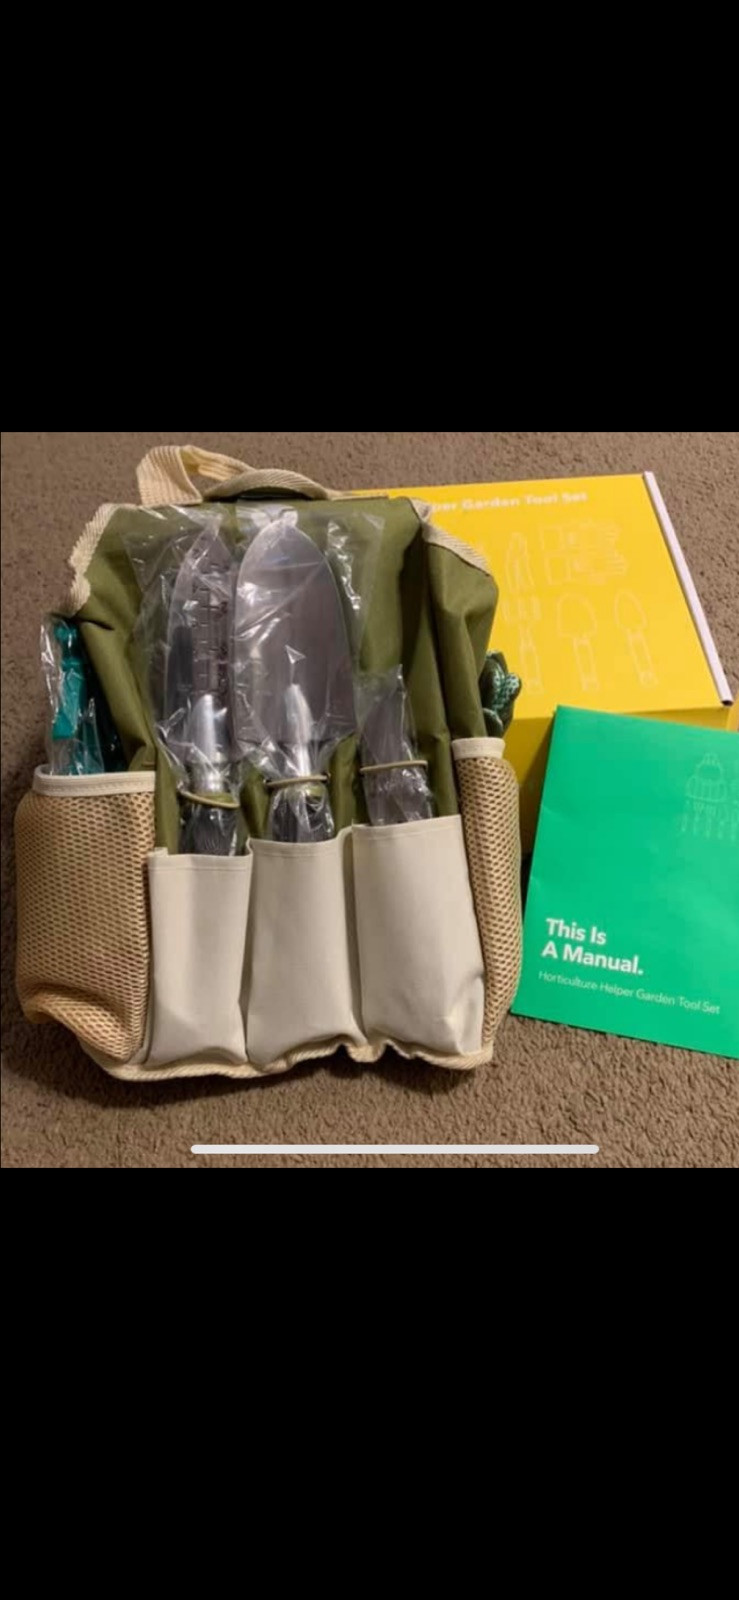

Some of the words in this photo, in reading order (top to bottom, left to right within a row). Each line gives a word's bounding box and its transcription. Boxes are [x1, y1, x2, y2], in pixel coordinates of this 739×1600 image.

[461, 496, 520, 511] Garden
[525, 493, 559, 505] Tool
[562, 491, 588, 503] Set
[546, 917, 587, 942] This
[590, 926, 607, 945] Is
[541, 940, 558, 959] A
[563, 943, 644, 976] Manual.
[538, 970, 598, 991] Horticulture
[600, 982, 634, 999] Helper
[636, 988, 676, 1006] Garden
[678, 996, 701, 1011] Tool
[702, 1001, 721, 1015] Set
